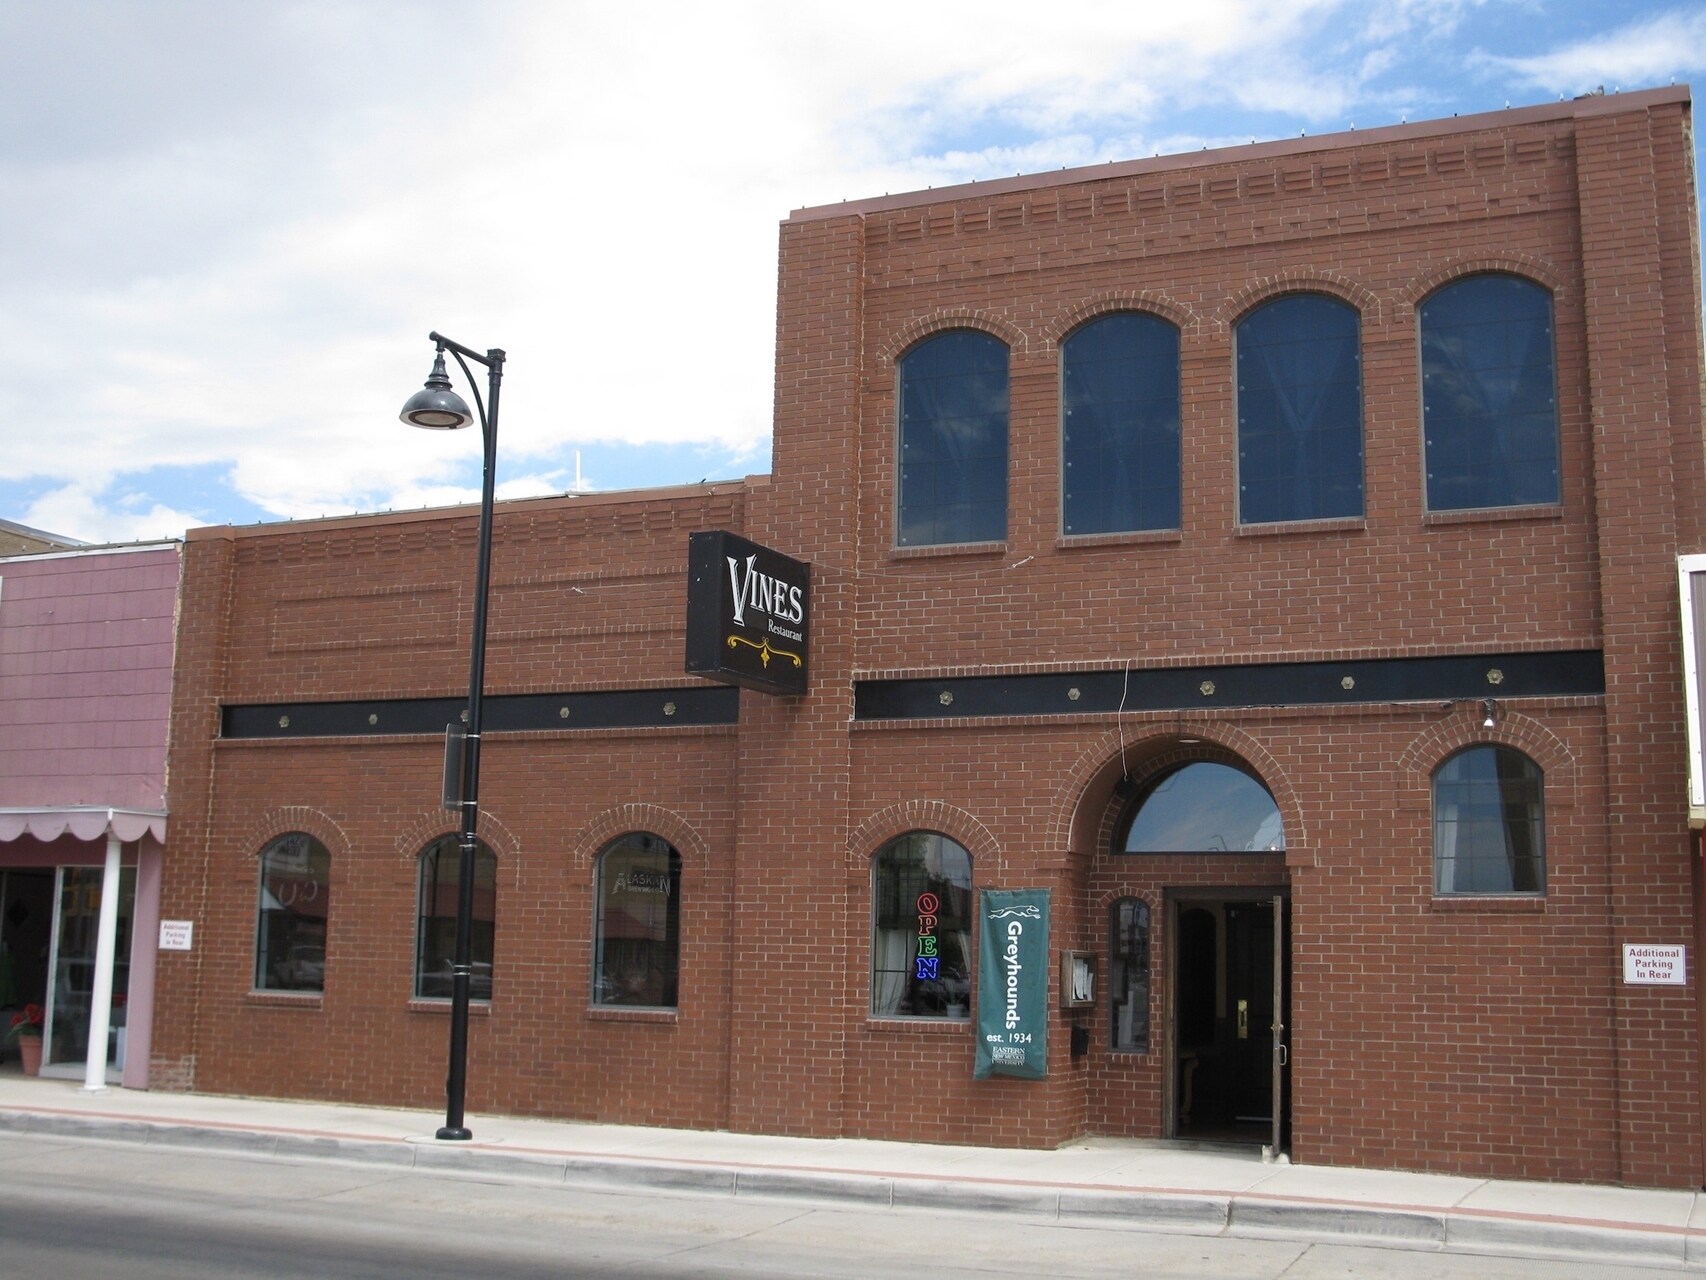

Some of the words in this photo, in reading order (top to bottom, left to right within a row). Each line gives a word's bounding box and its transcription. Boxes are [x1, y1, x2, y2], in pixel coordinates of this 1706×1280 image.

[726, 553, 803, 627] VINES
[768, 618, 802, 642] Restaurant
[611, 873, 671, 897] ALASKAN
[166, 931, 186, 940] Parking
[916, 892, 939, 979] OPEN
[1629, 949, 1679, 957] Additional
[1635, 960, 1673, 970] Parking
[1003, 920, 1023, 1030] Greyhounds
[1637, 970, 1646, 978] In
[1649, 970, 1672, 979] Rear
[986, 1034, 1005, 1043] est.
[1009, 1033, 1032, 1043] 1934
[992, 1046, 1026, 1054] EASTERN
